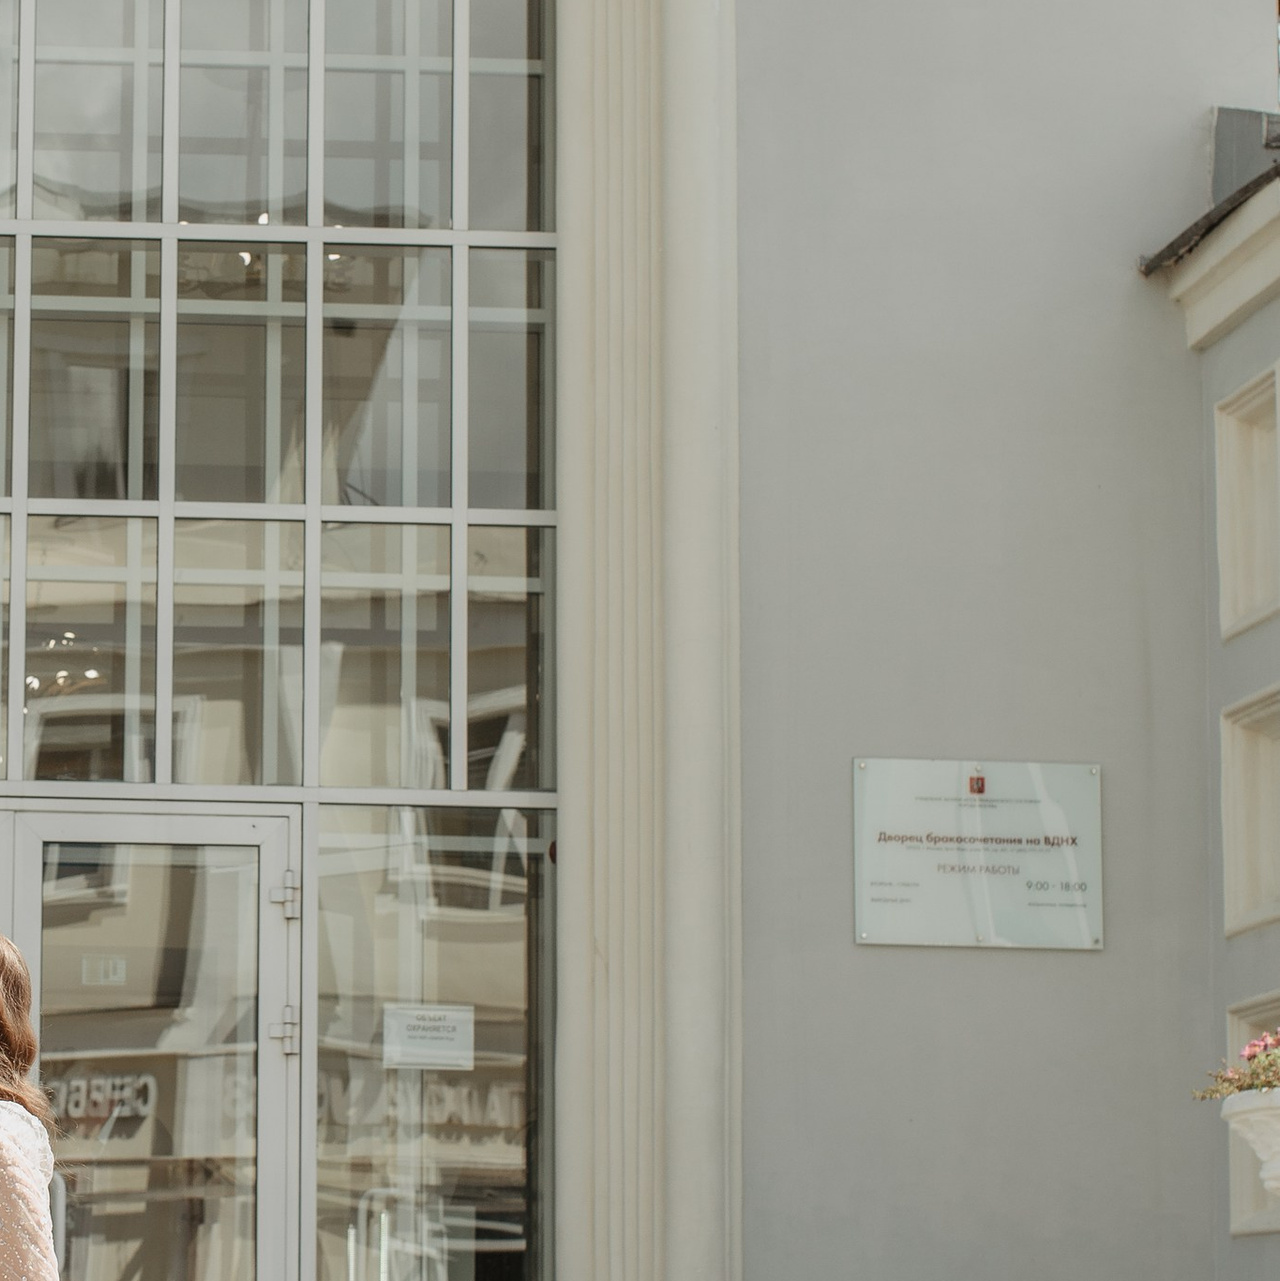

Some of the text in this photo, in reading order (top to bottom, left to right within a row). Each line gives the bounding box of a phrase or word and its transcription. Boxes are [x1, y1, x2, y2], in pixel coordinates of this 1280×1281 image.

[877, 832, 1078, 848] Дворец бракосочетания на ВДНХ
[937, 864, 1020, 875] РЕЖИМ РАБОТЫ
